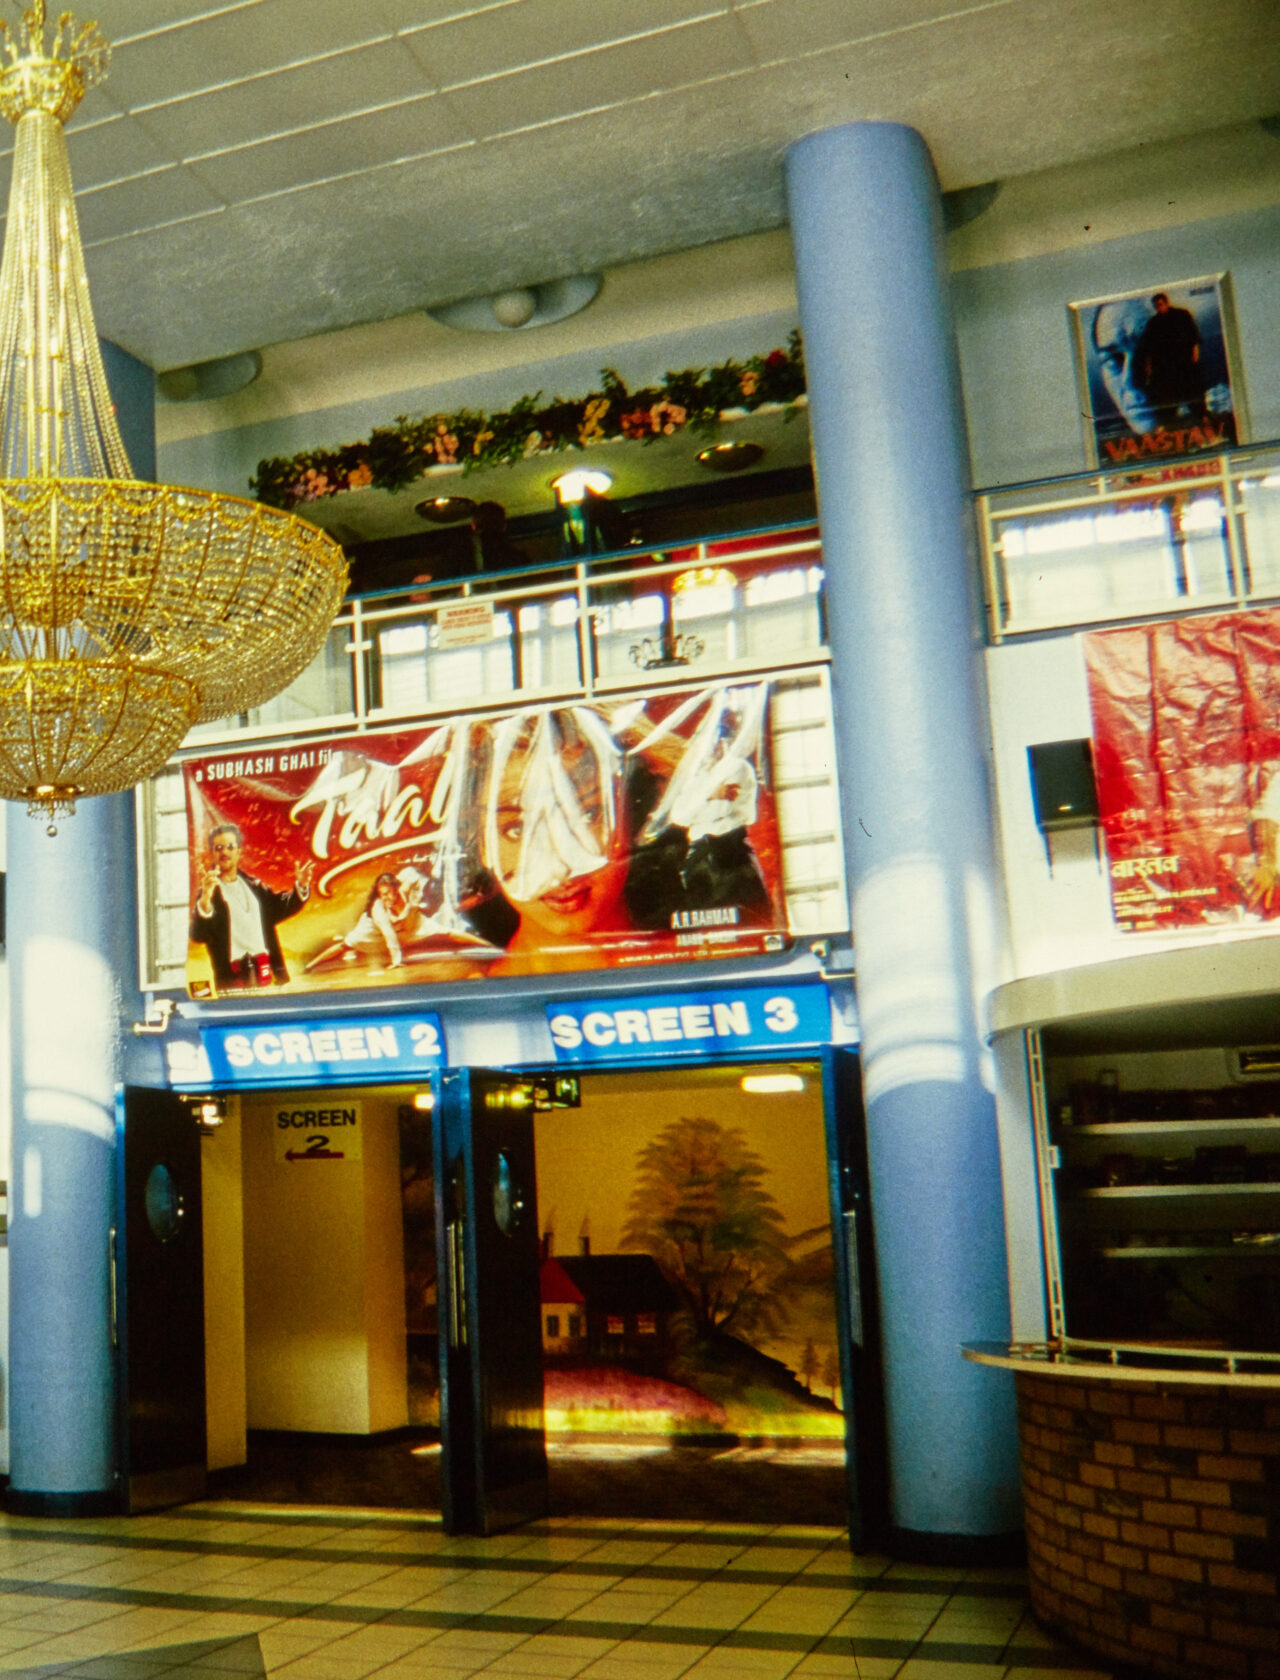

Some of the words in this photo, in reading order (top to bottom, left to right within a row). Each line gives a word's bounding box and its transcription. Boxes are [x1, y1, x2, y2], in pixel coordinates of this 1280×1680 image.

[195, 769, 202, 782] a
[207, 757, 274, 781] SUBHASH
[279, 752, 315, 771] GHAI
[289, 751, 455, 859] Taal
[550, 1001, 751, 1049] SCREEN
[763, 996, 799, 1033] 3
[224, 1026, 399, 1067] SCREEN
[410, 1023, 441, 1056] 2
[277, 1108, 356, 1129] SCREEN
[305, 1135, 330, 1153] 2
